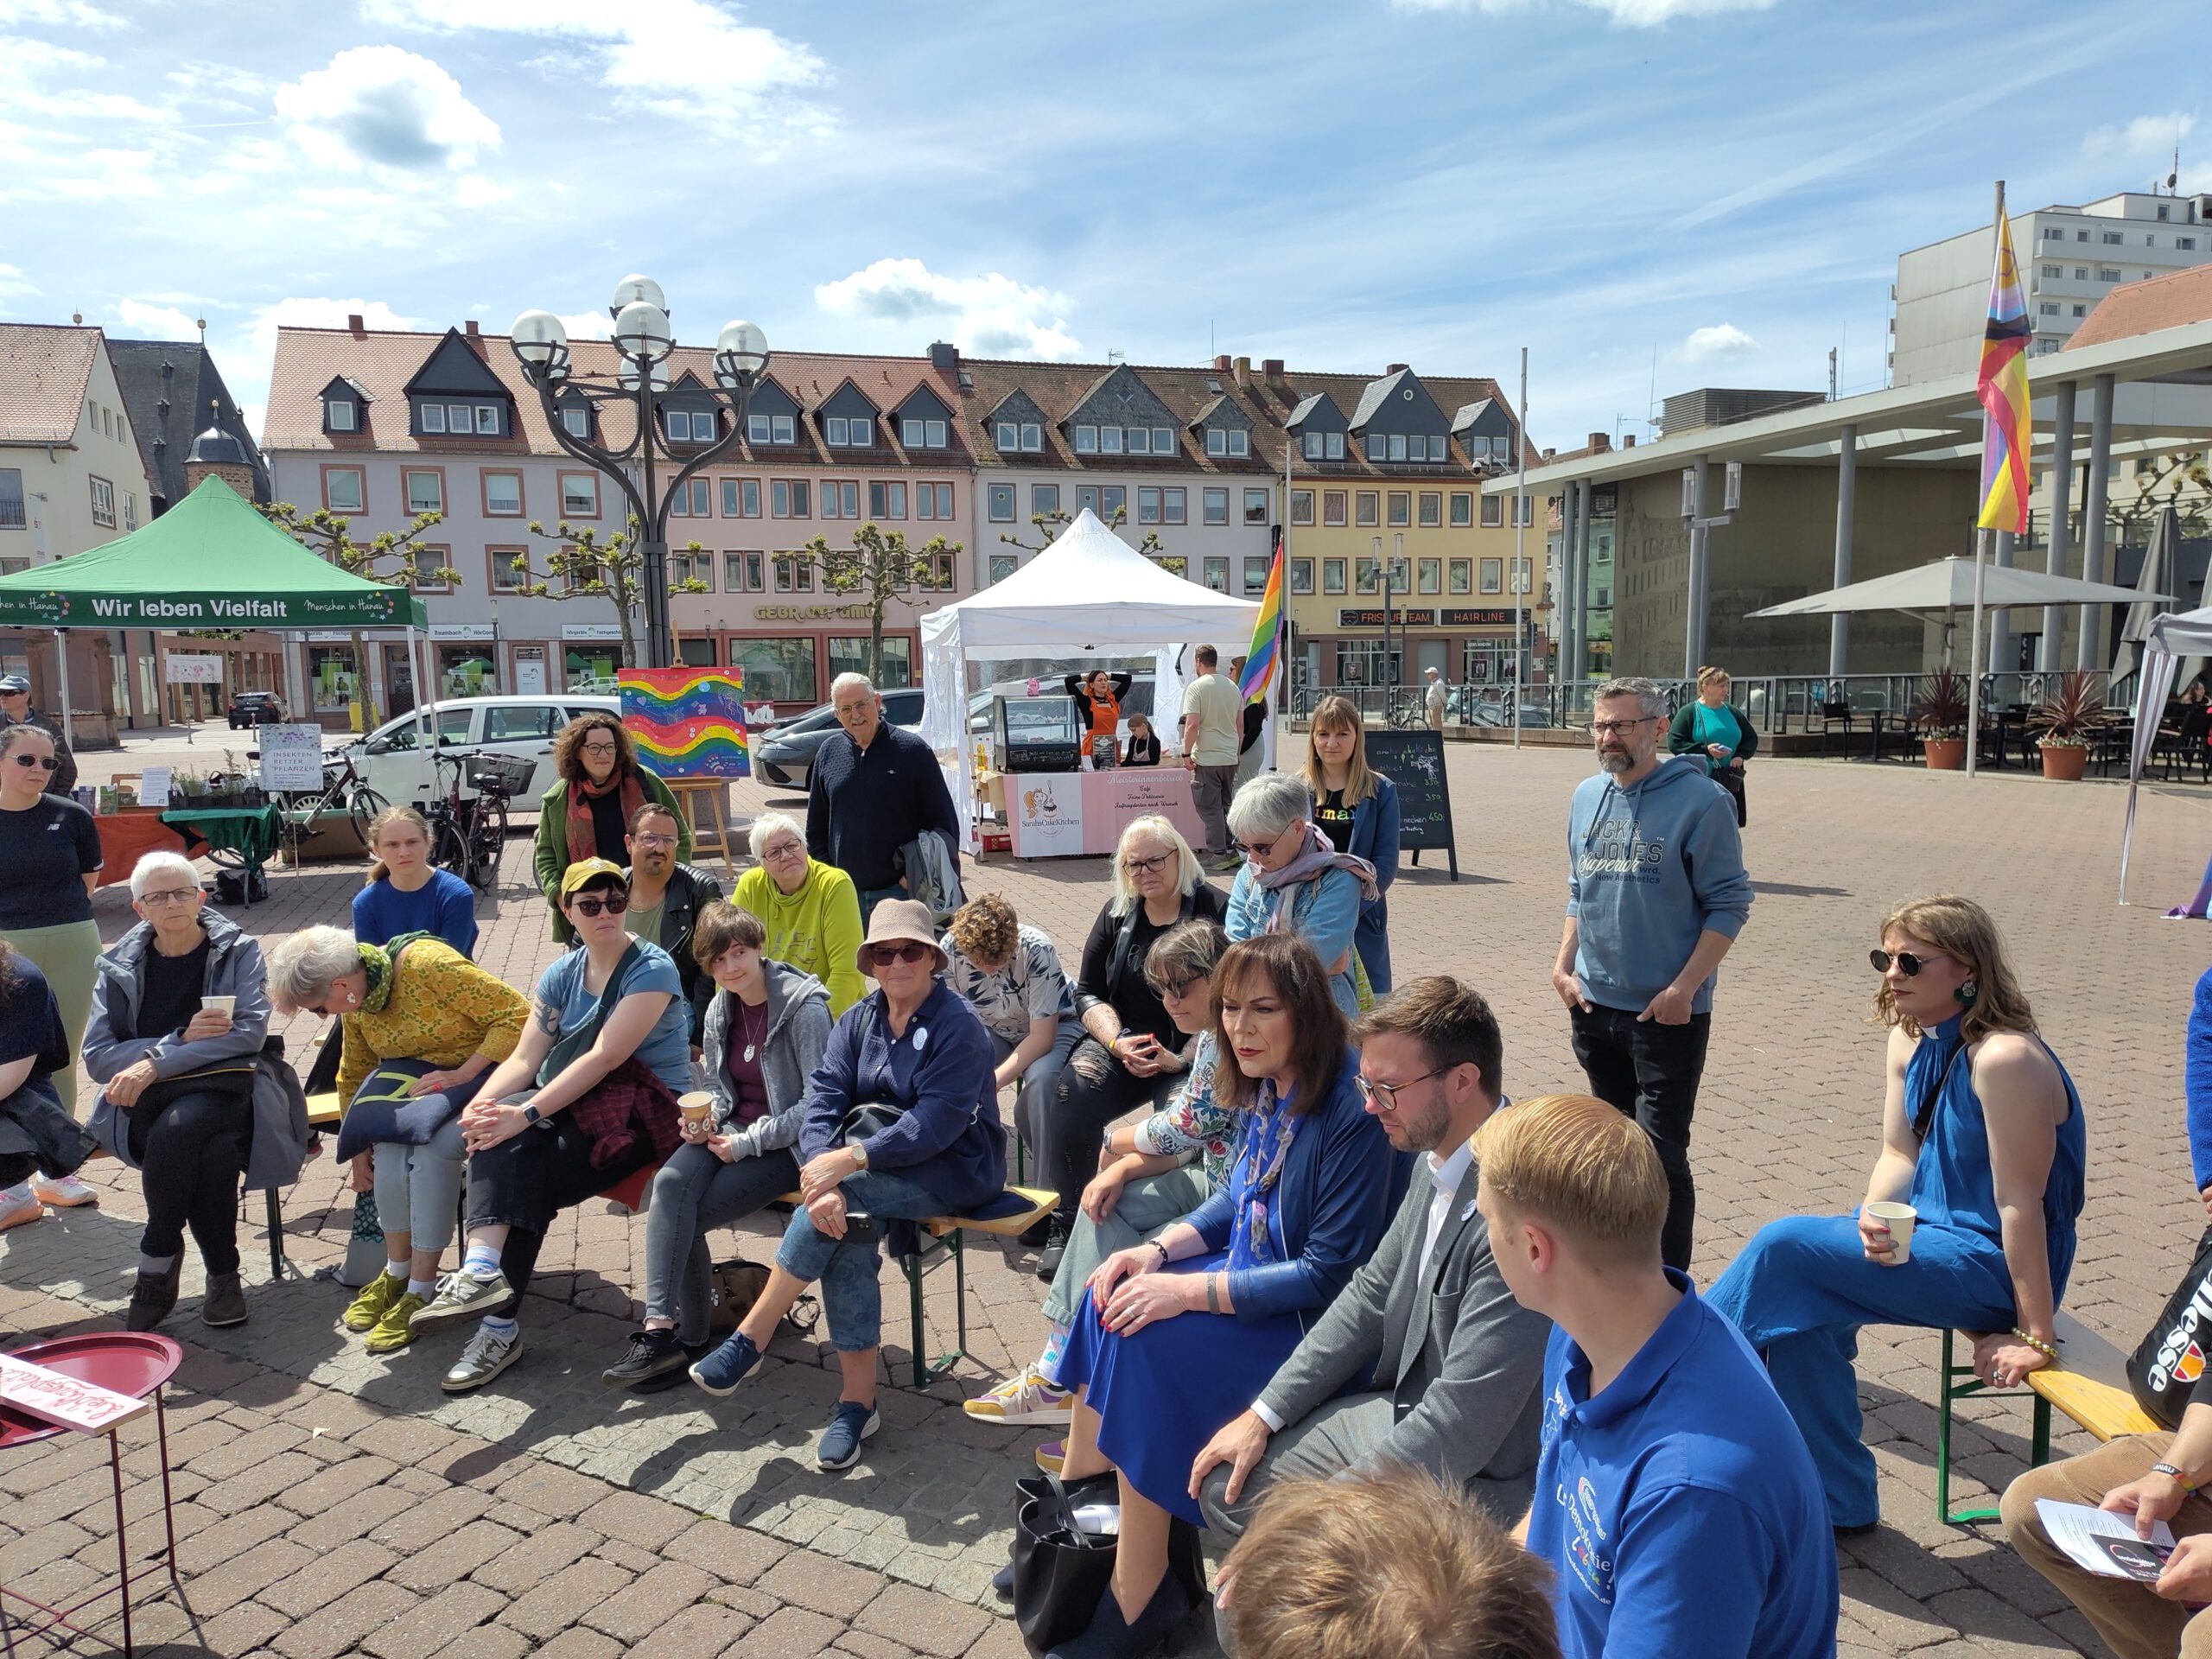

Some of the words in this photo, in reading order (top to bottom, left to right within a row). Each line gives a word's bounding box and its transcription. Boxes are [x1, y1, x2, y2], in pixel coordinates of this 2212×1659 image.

[29, 597, 59, 611] Hanau
[92, 599, 131, 617] Wir
[140, 599, 203, 617] leben
[209, 599, 288, 617] Vielfalt
[304, 598, 346, 612] Menschen
[349, 601, 357, 610] in
[358, 598, 385, 611] Hanau
[1453, 612, 1506, 622] HAIRLINE
[1021, 817, 1080, 827] SarahsCakeKitchen
[1578, 852, 1640, 878] Superior
